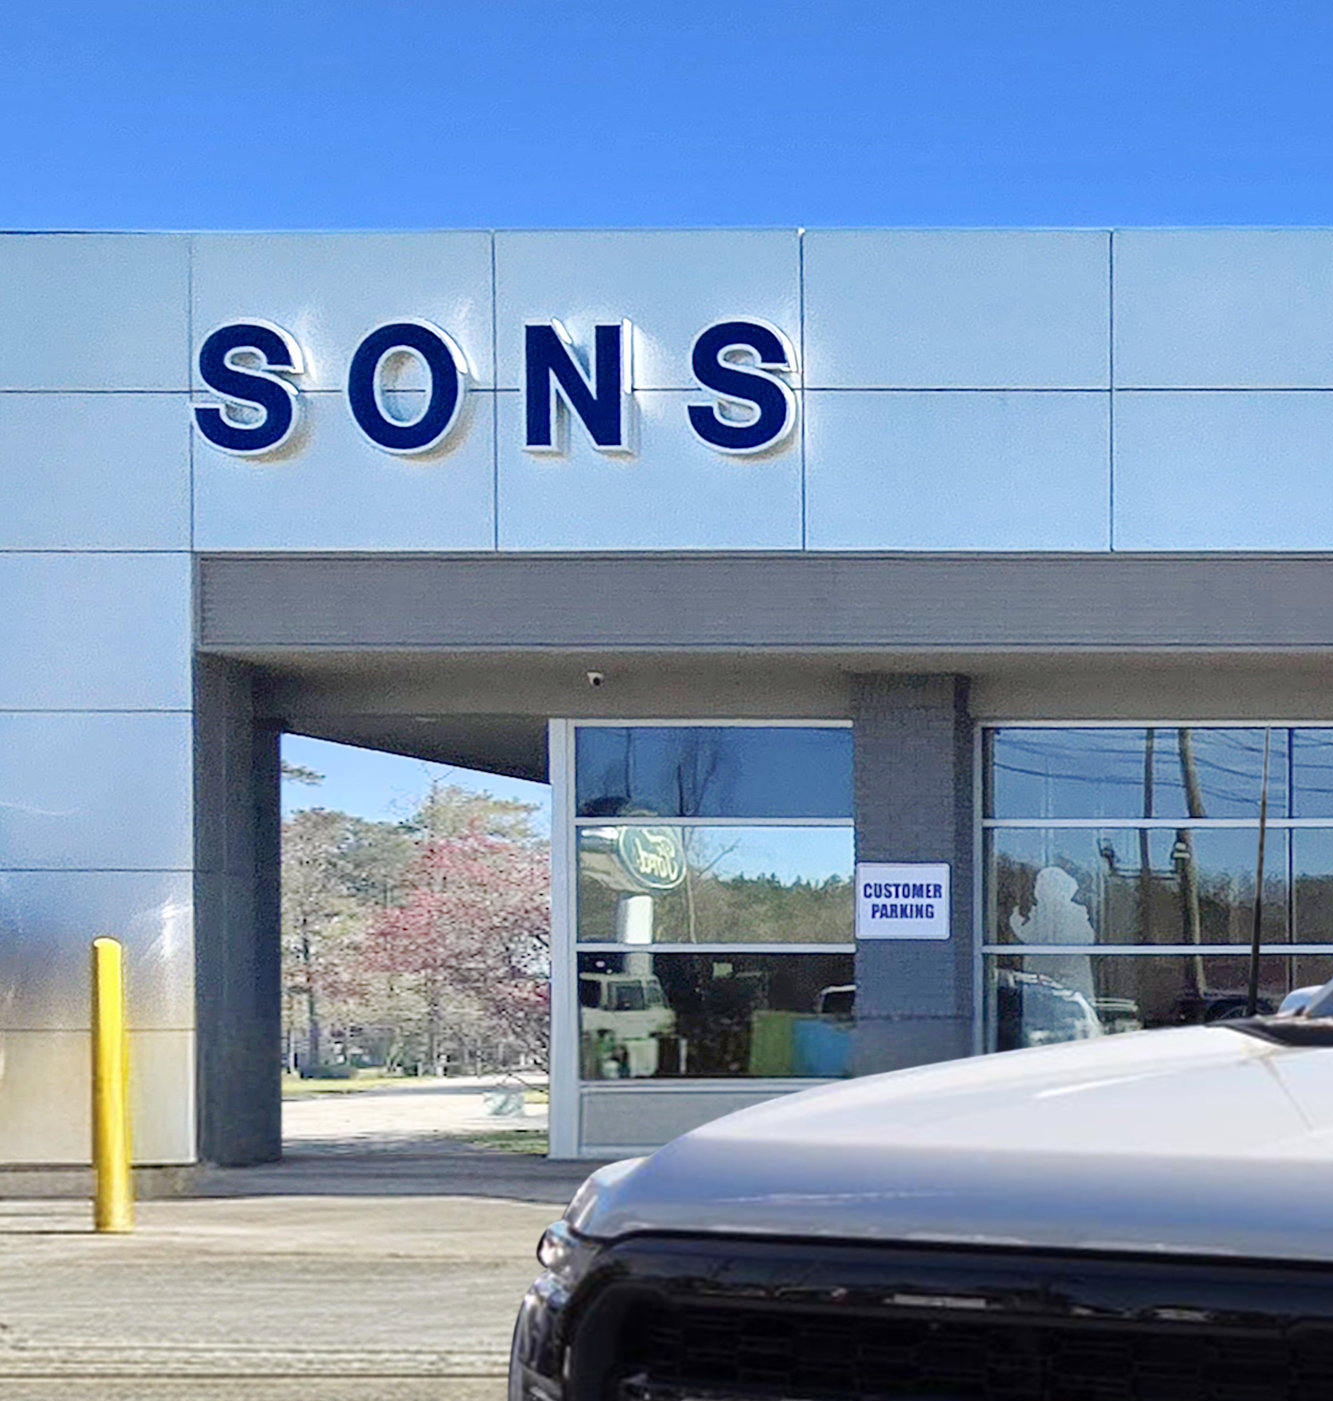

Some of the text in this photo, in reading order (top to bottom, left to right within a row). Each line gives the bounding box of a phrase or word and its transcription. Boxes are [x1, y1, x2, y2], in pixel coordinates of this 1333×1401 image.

[192, 319, 800, 454] SONS
[863, 882, 943, 899] CUSTOMER
[871, 903, 935, 919] PARKING
